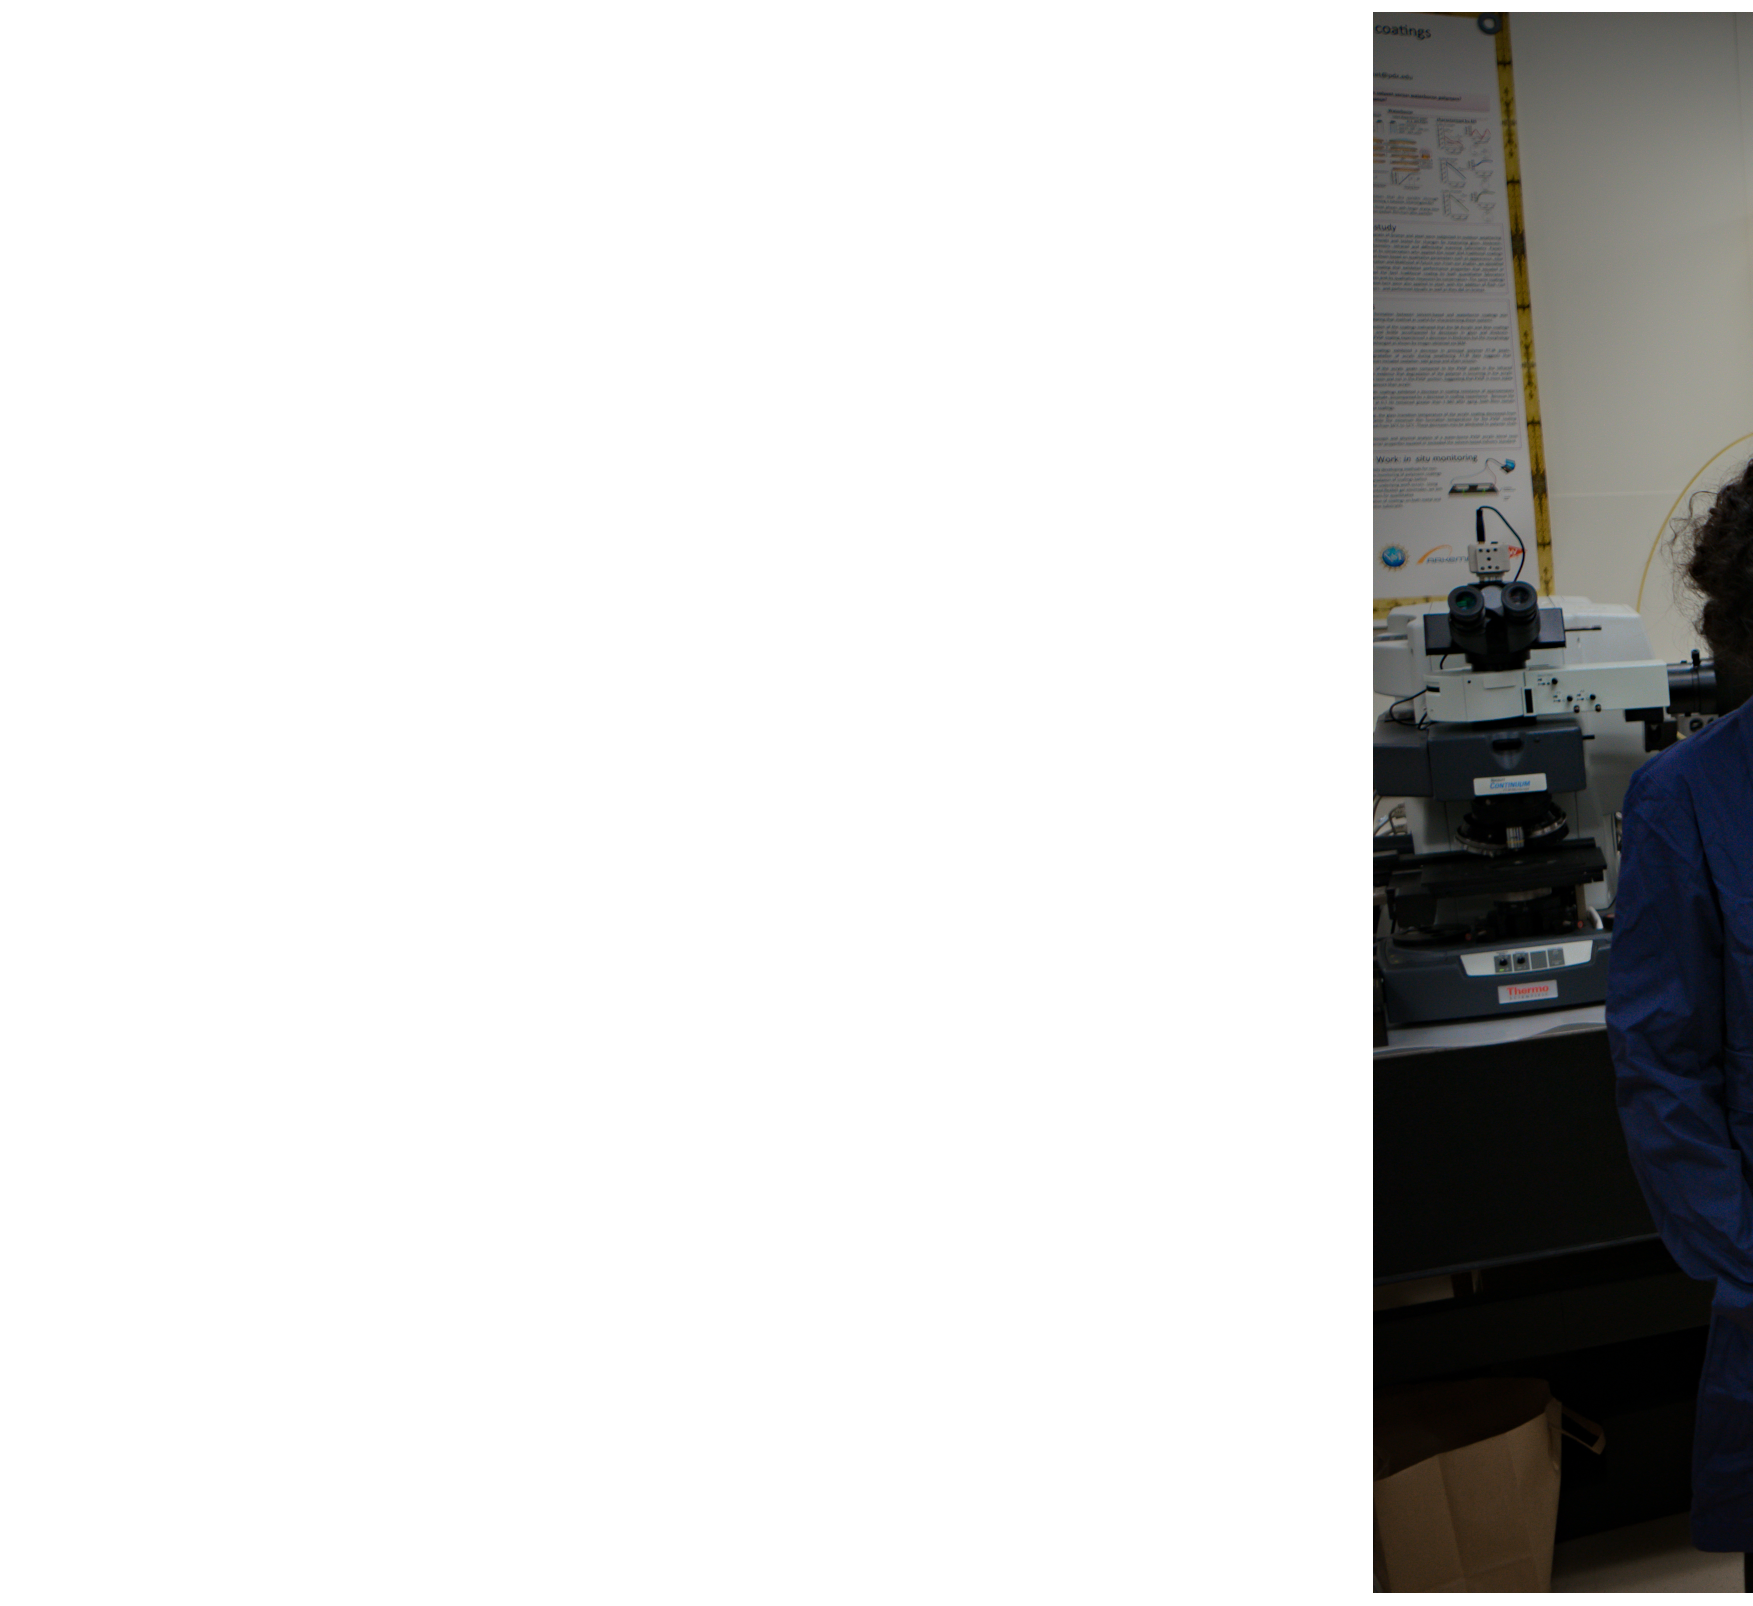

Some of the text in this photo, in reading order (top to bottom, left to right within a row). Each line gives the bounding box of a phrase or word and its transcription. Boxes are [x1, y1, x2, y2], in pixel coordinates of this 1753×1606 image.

[1375, 24, 1432, 40] coatings
[1374, 223, 1397, 233] study
[1403, 455, 1411, 463] in
[1415, 455, 1430, 463] situ
[1432, 453, 1478, 463] monitoring
[1490, 780, 1531, 790] CONTINUUM
[1506, 985, 1549, 996] Thermo
